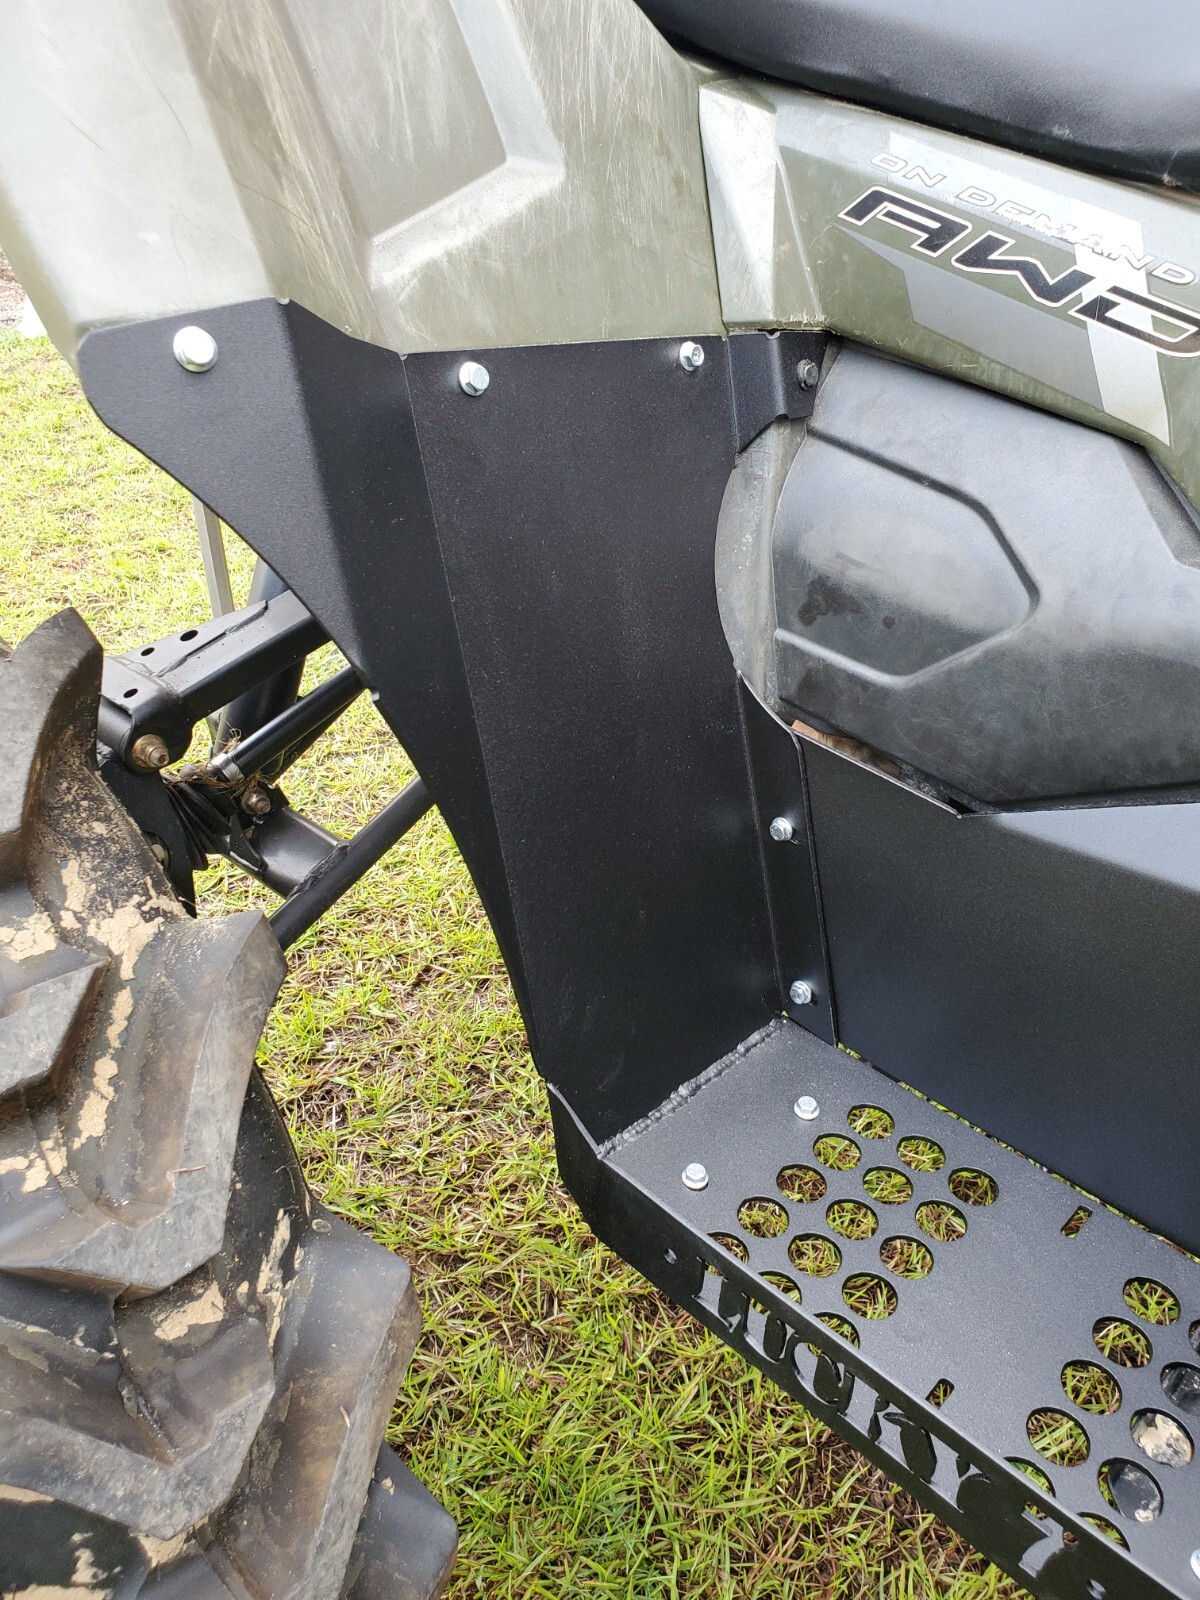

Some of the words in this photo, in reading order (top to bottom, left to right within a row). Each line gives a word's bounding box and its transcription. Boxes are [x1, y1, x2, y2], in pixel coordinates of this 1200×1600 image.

[838, 185, 1200, 357] AWD
[870, 151, 947, 187] ON
[955, 186, 1199, 287] DEMAND
[692, 1256, 991, 1513] LUCKY
[1018, 1501, 1079, 1579] 7
